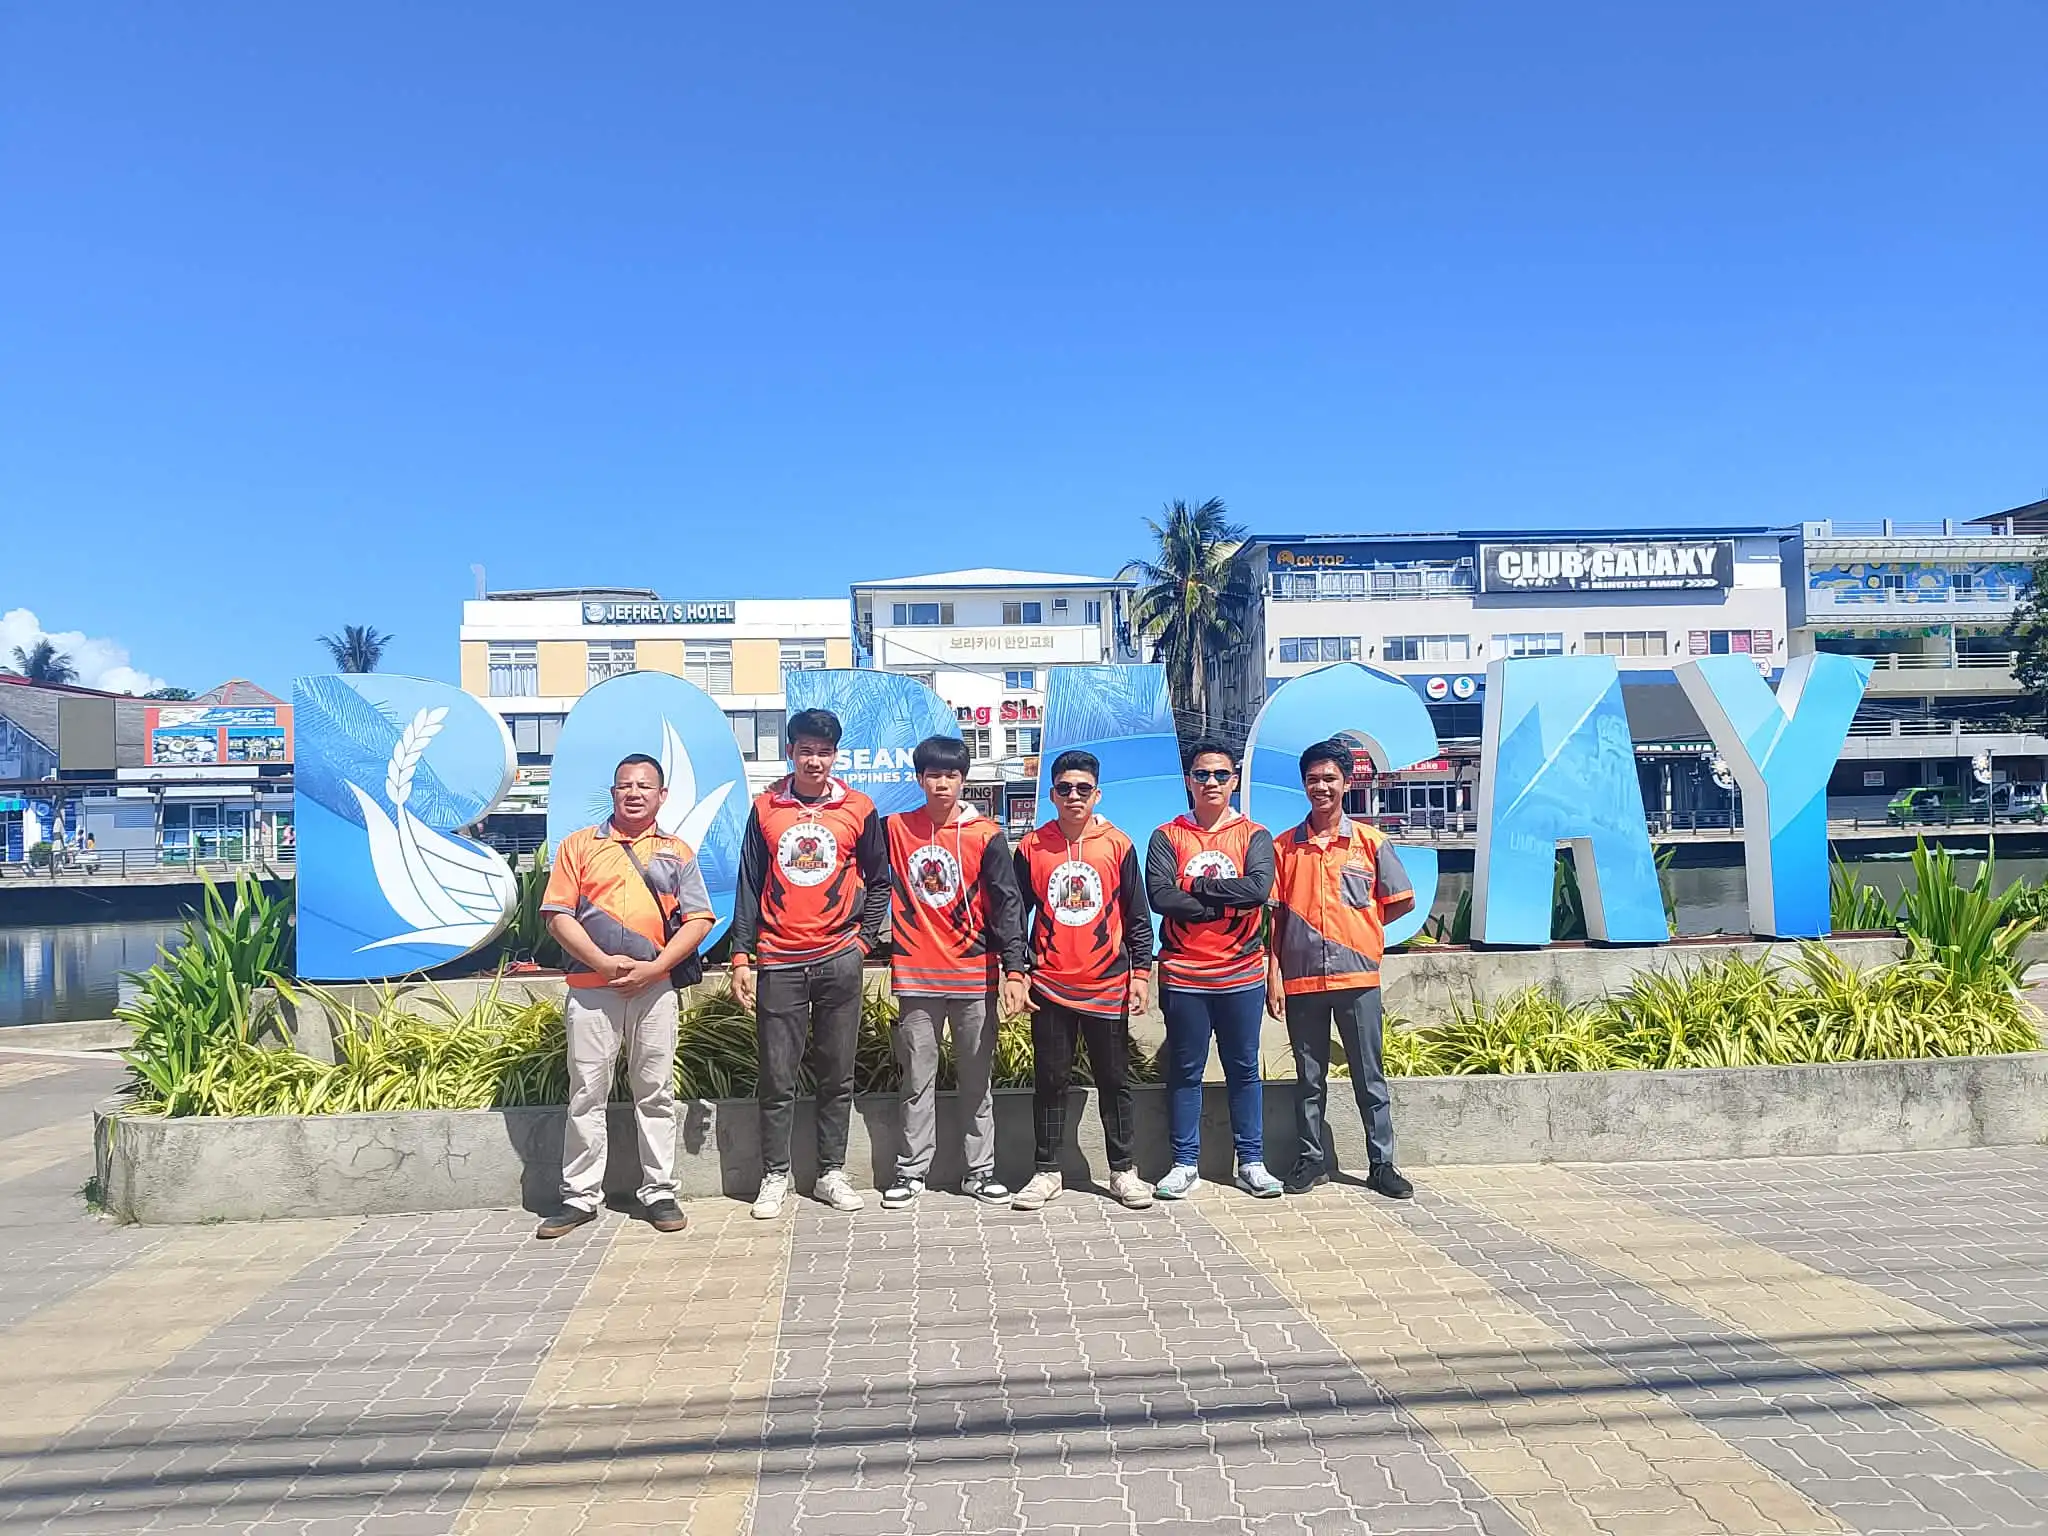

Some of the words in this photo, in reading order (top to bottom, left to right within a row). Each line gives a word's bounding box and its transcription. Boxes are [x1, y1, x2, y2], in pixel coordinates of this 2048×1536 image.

[1498, 550, 1585, 579] CLUB
[1591, 547, 1717, 577] GALAXY
[1591, 580, 1647, 589] MINUTES
[1649, 579, 1684, 588] AWAY
[607, 603, 669, 620] JEFFREY
[687, 602, 734, 620] HOTEL
[1004, 635, 1054, 650] 한인교회
[832, 747, 917, 771] SEAN
[1414, 761, 1438, 770] Lake
